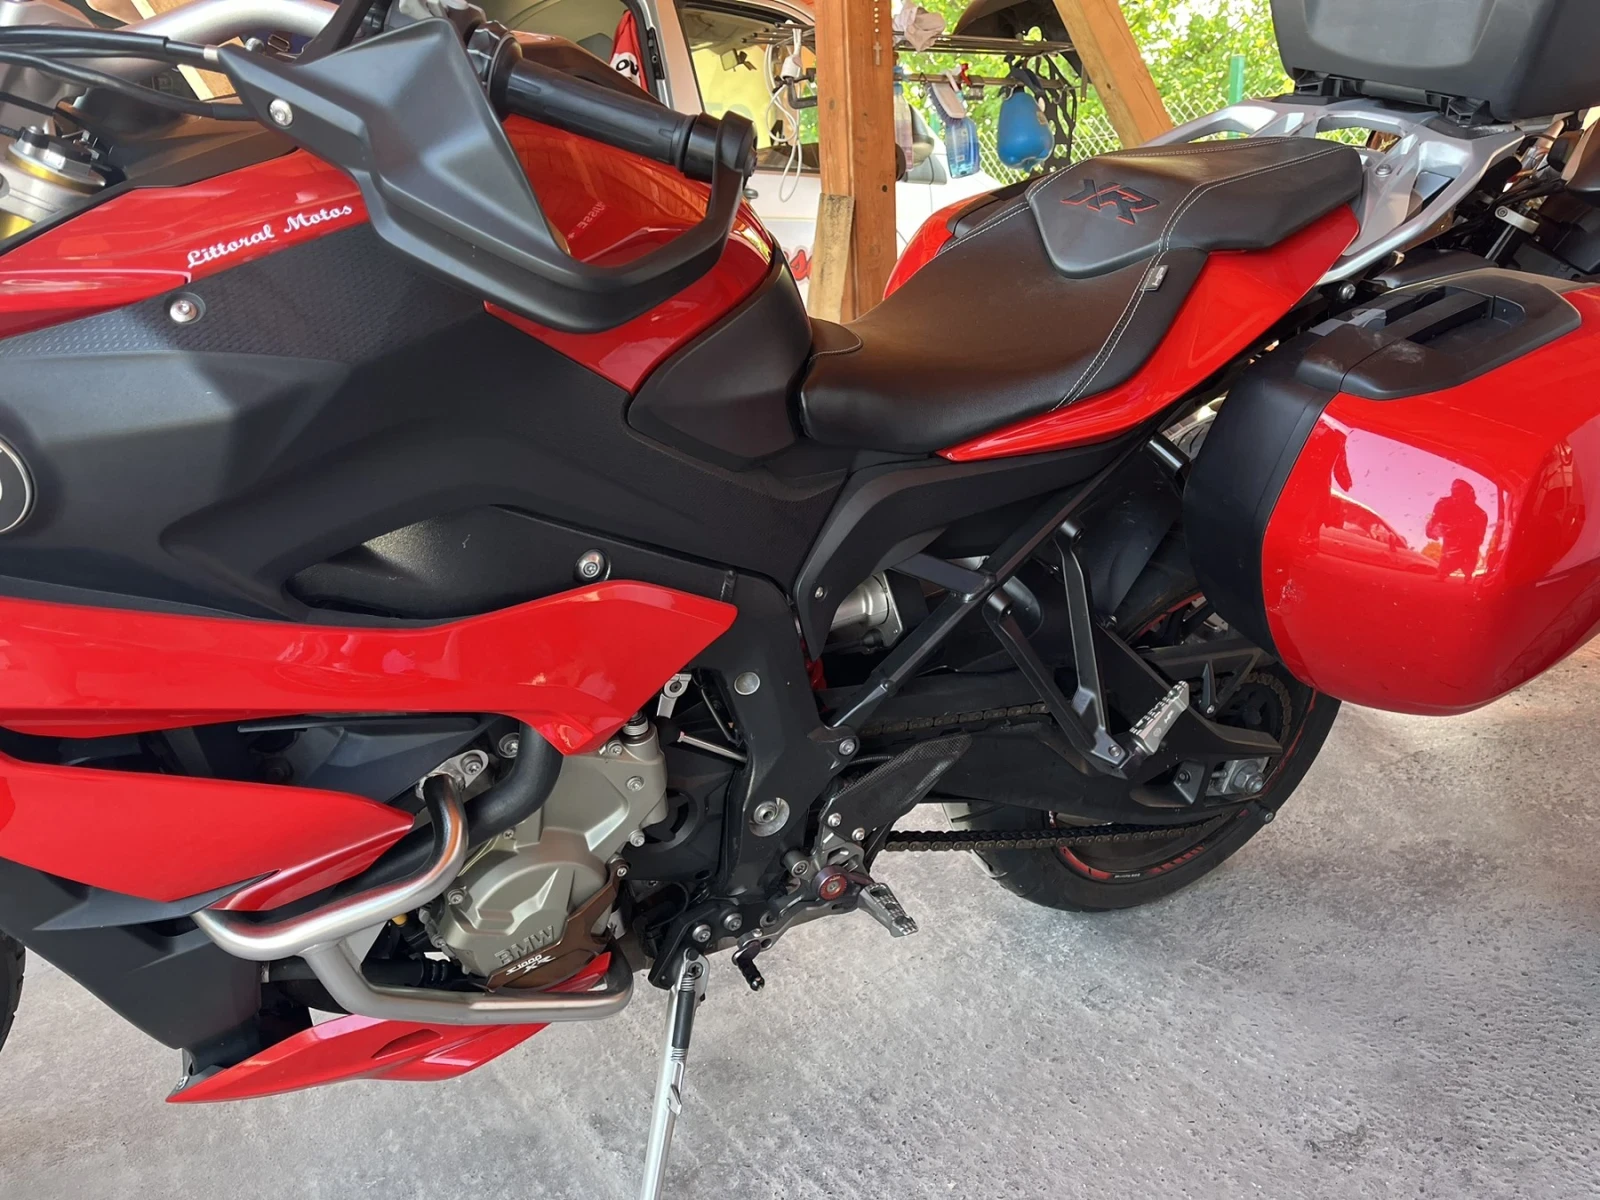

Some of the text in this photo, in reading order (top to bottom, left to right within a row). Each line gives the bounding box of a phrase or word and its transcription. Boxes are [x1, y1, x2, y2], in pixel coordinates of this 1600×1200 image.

[1060, 179, 1160, 225] XR
[187, 204, 353, 268] Littoral Motos
[494, 925, 556, 965] BMW
